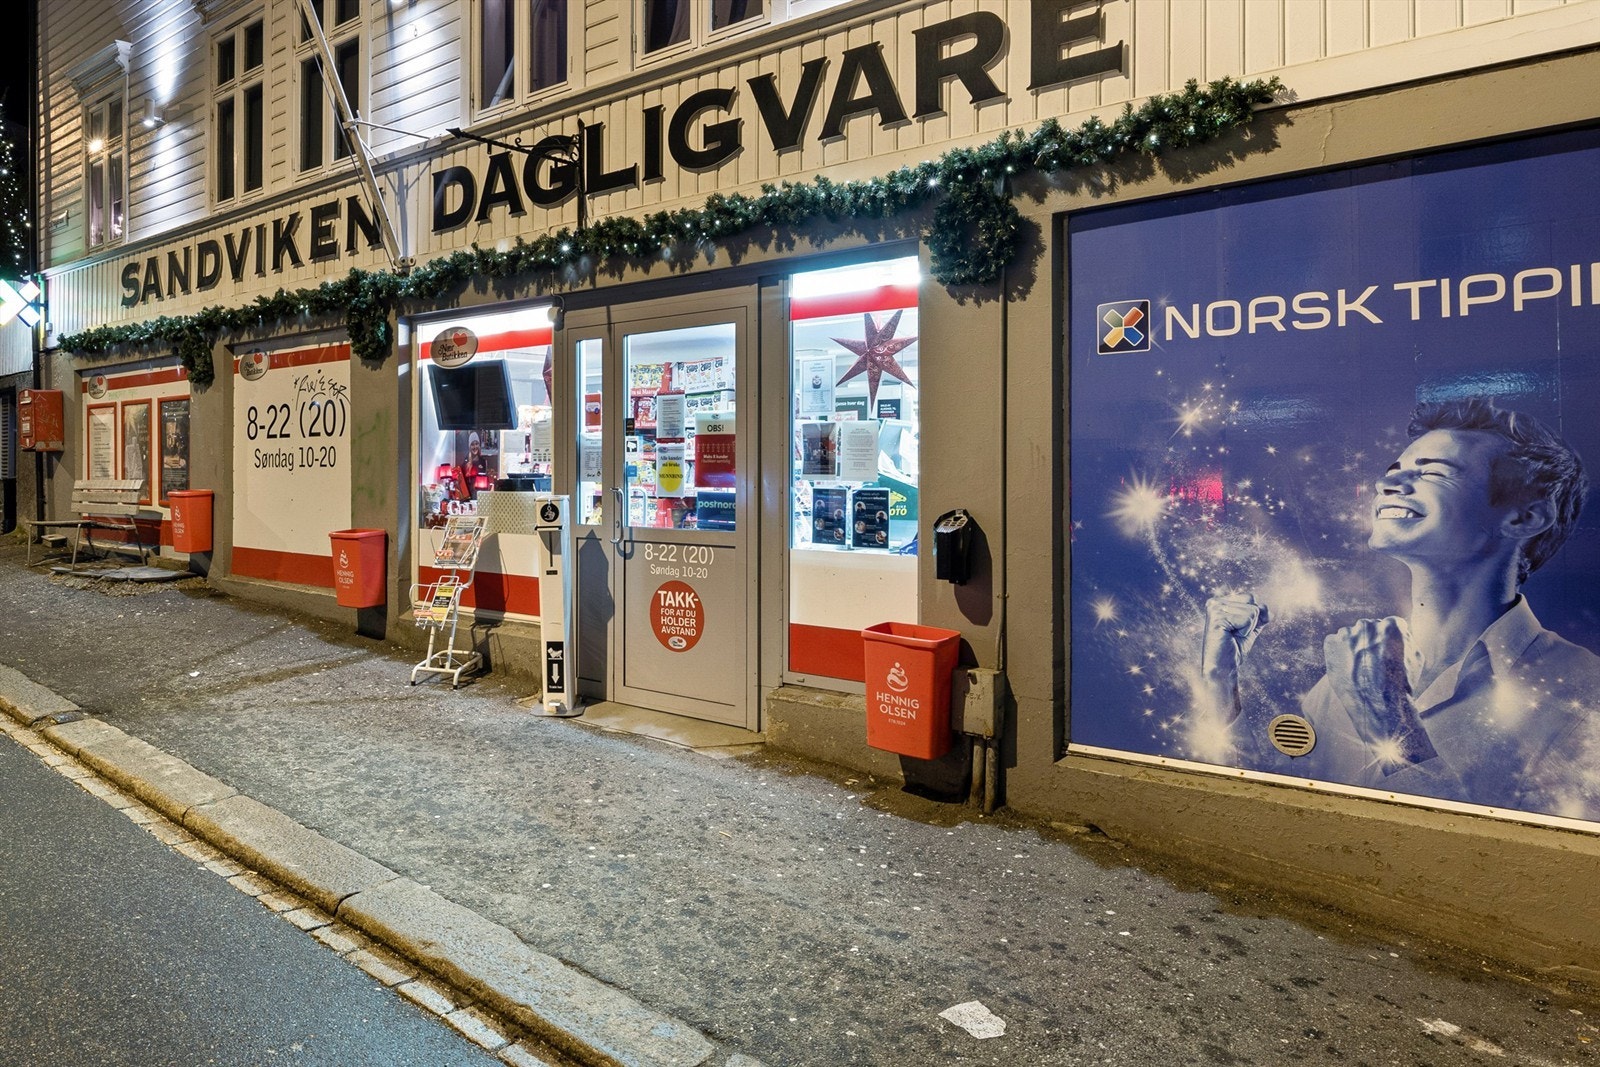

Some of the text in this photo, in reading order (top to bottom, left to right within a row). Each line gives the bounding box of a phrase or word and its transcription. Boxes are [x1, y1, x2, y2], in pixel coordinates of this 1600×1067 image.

[121, 0, 1123, 308] SANDVIKEN DAGLIGVARE
[1165, 262, 1600, 341] NORSK TIPPI
[441, 351, 468, 361] Butikken
[247, 399, 346, 440] 8-22 (20)
[254, 446, 336, 471] Søndag 10-20
[644, 543, 714, 565] 8-22 (20)
[650, 564, 708, 578] Søndag 10-20
[658, 590, 699, 608] TAKK-
[661, 616, 696, 627] HOLDER
[661, 626, 696, 636] AVSTAND
[876, 692, 919, 709] HENNIG
[880, 704, 916, 719] OLSEN
